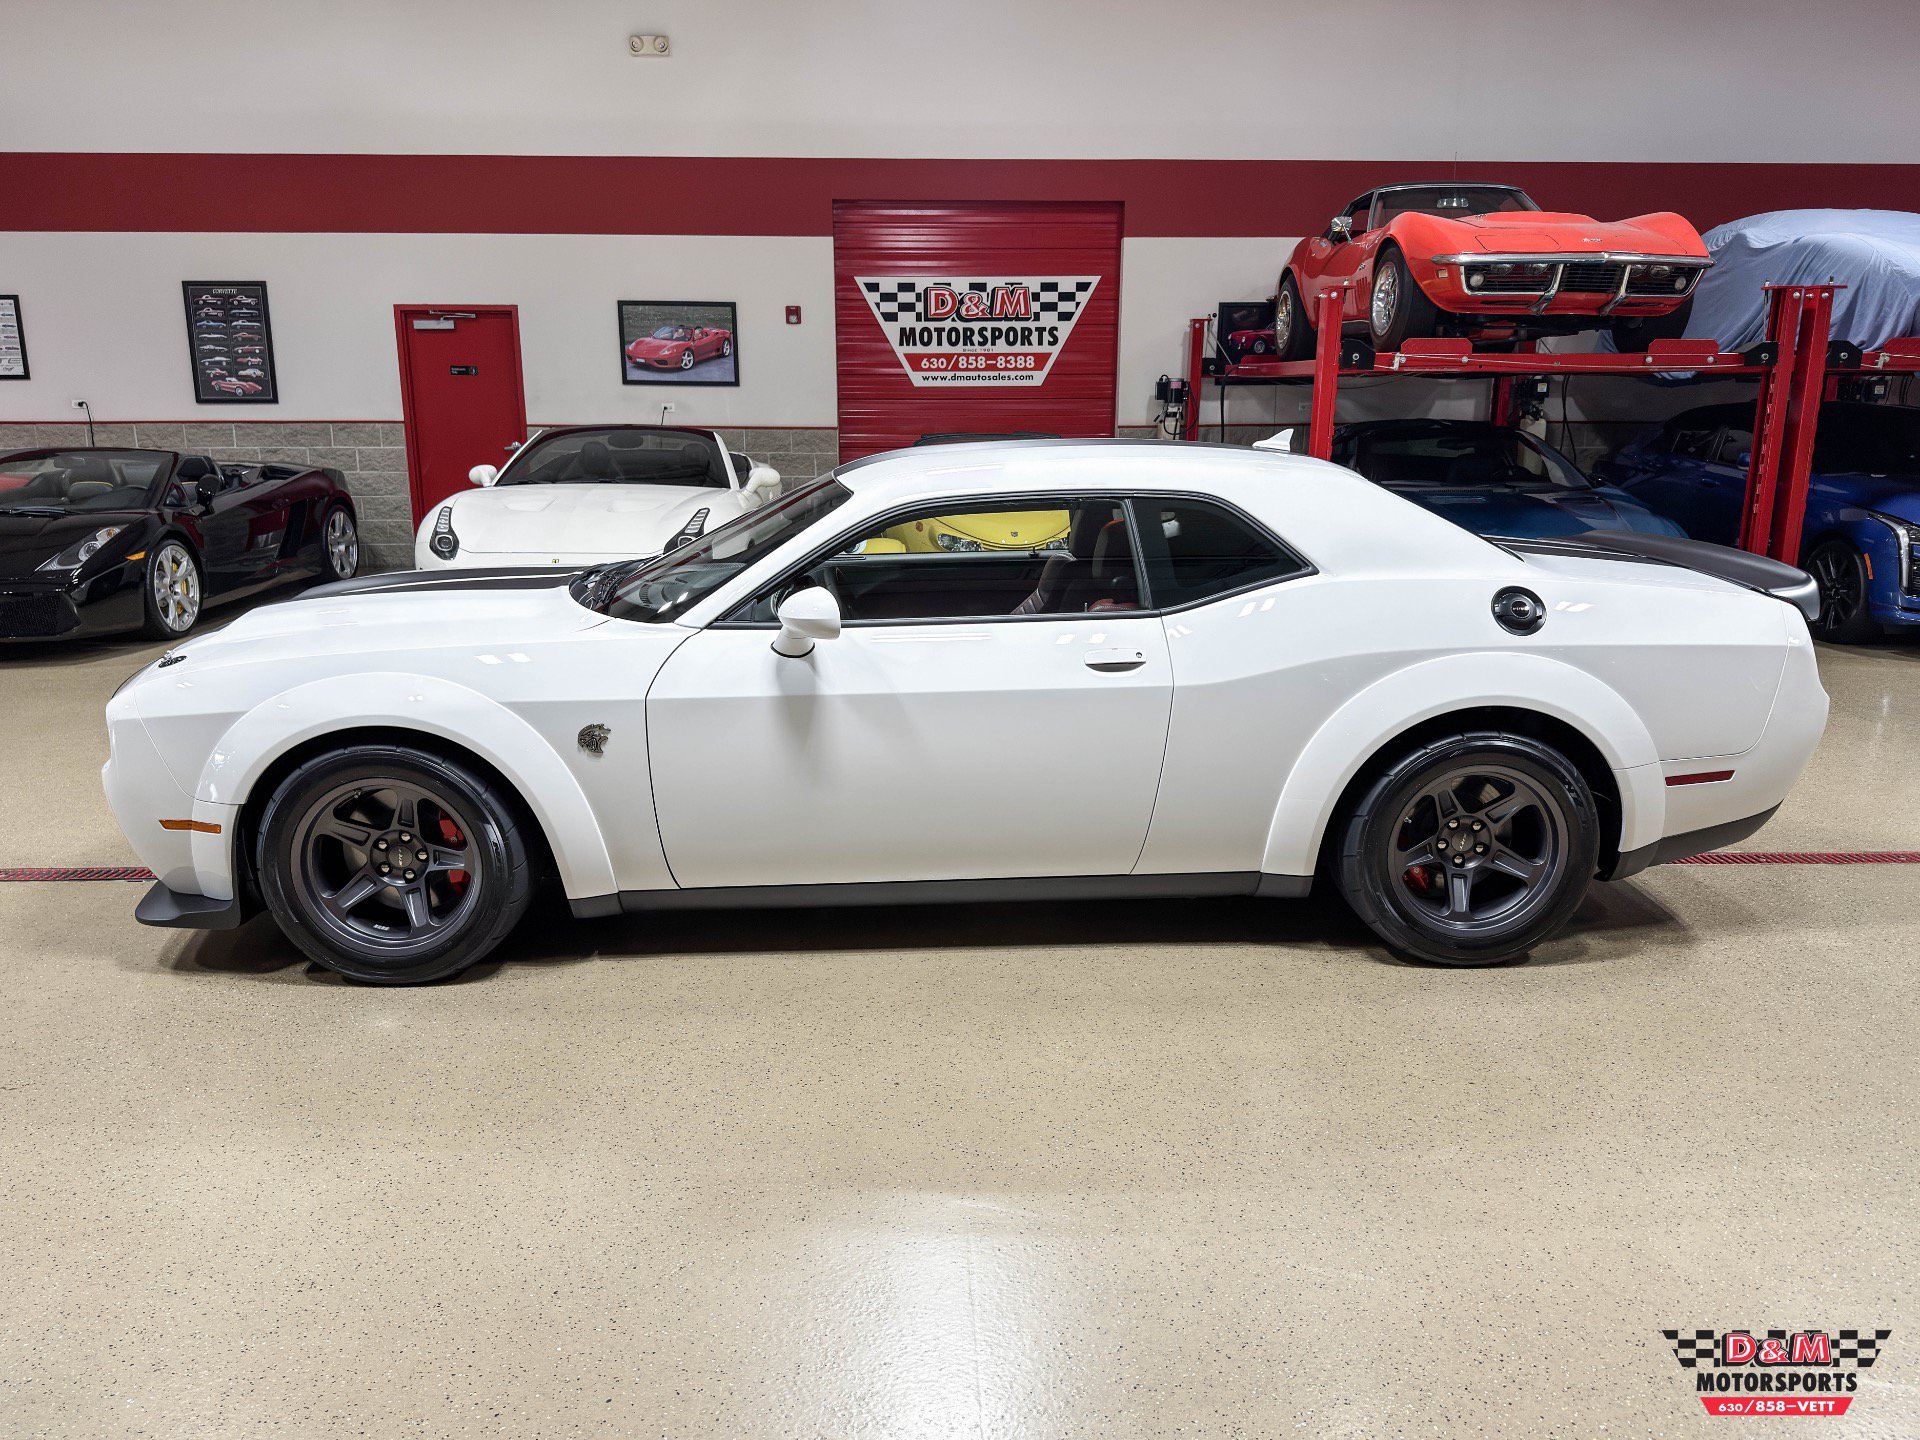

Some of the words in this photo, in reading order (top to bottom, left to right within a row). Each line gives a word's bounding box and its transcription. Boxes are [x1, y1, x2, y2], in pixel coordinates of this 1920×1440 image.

[923, 286, 1034, 322] D&M
[899, 326, 1059, 347] MOTORSPORTS
[921, 355, 1035, 370] 630/858-8388
[921, 372, 1034, 382] www.dmautosales.com
